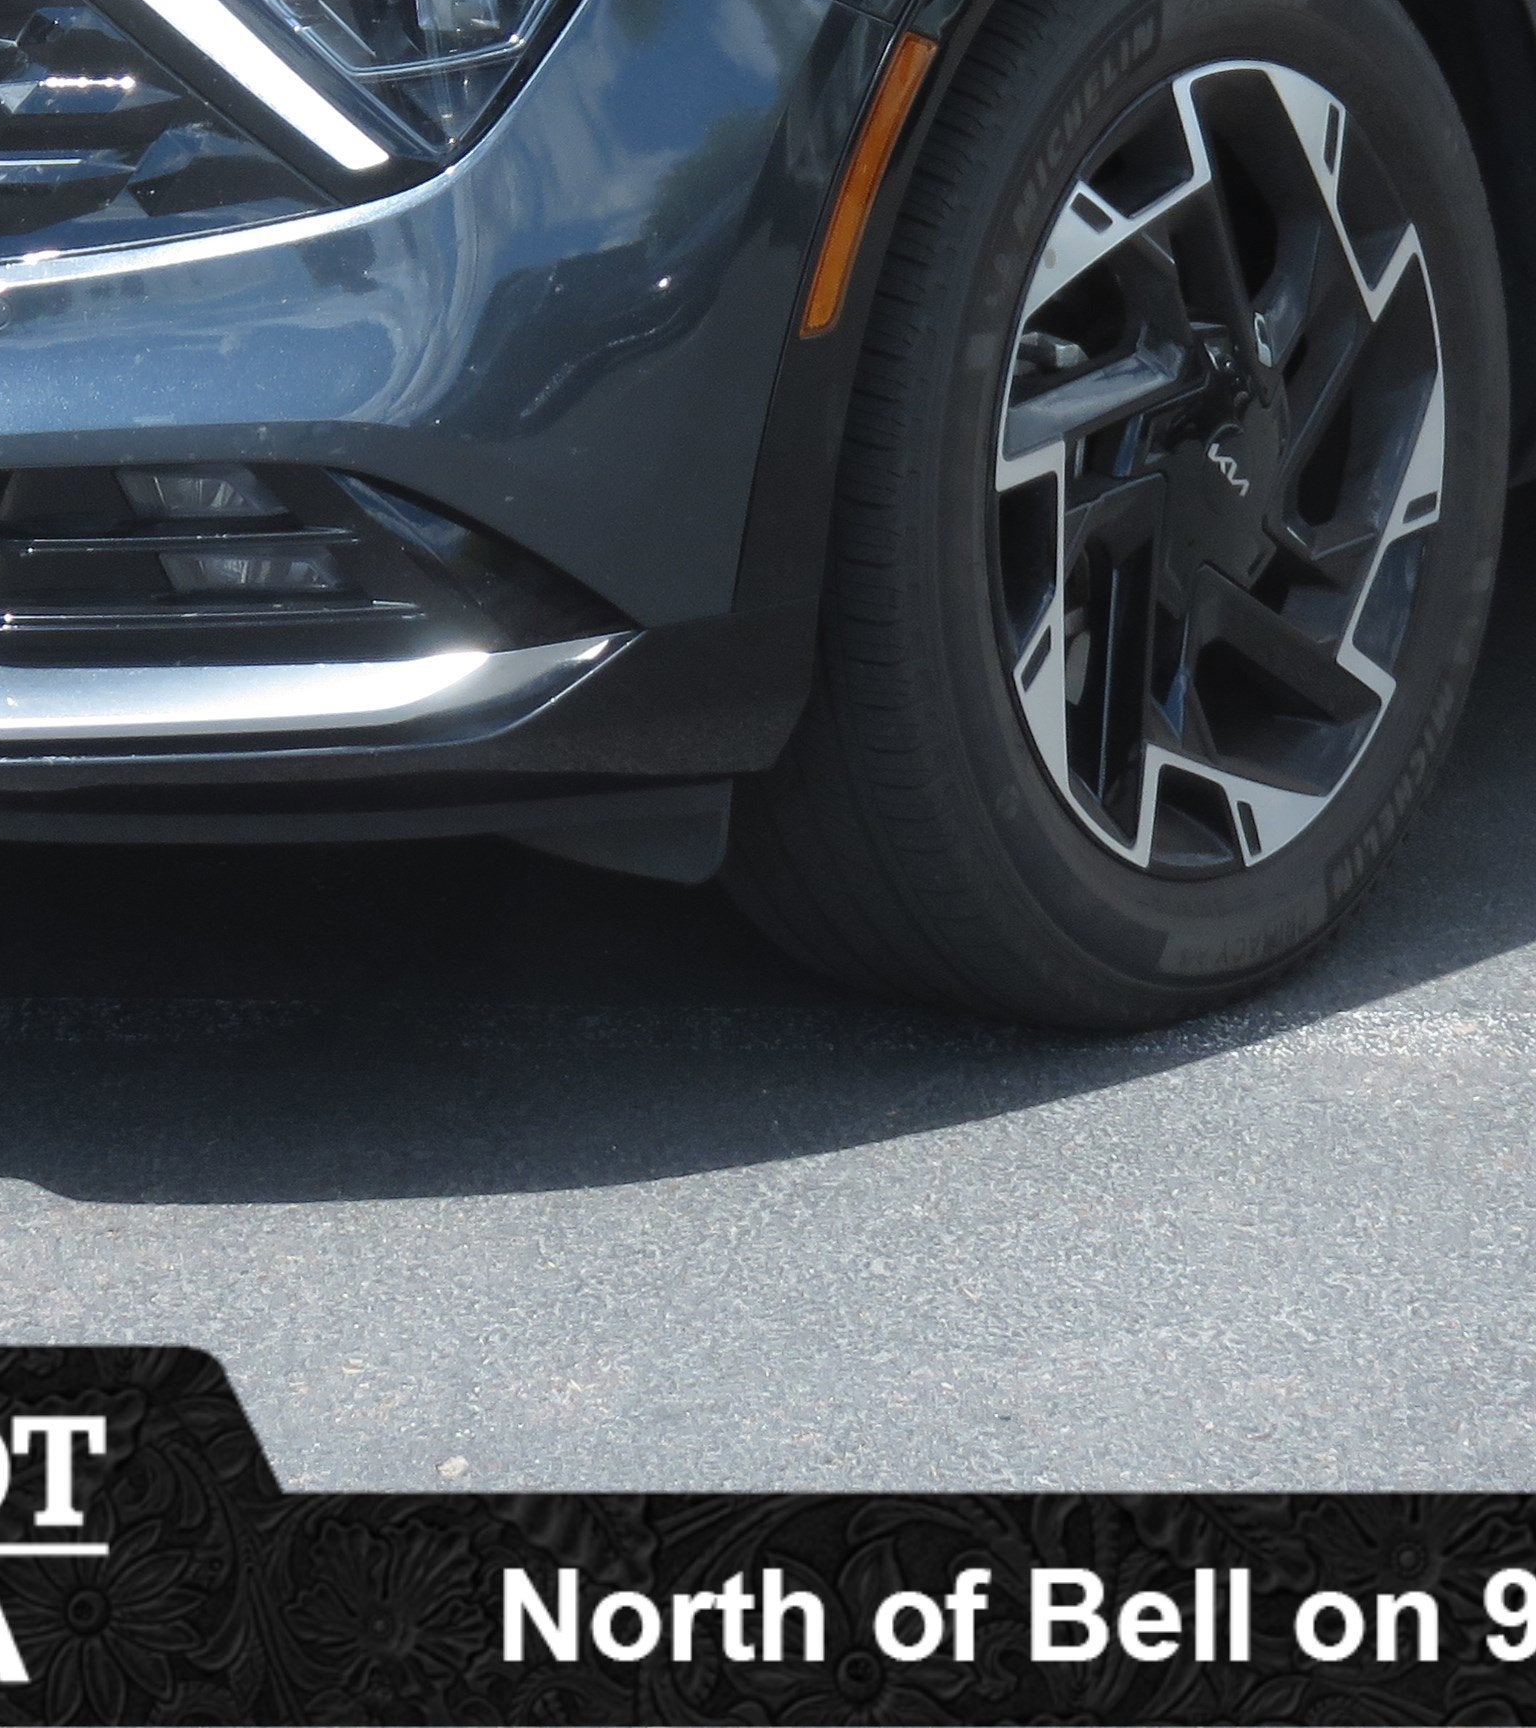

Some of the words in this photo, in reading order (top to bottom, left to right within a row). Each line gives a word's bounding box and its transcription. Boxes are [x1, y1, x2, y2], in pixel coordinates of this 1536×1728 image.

[1012, 13, 1156, 238] MICHELIN
[1207, 443, 1250, 497] KIA
[1331, 681, 1455, 899] MICHELIN
